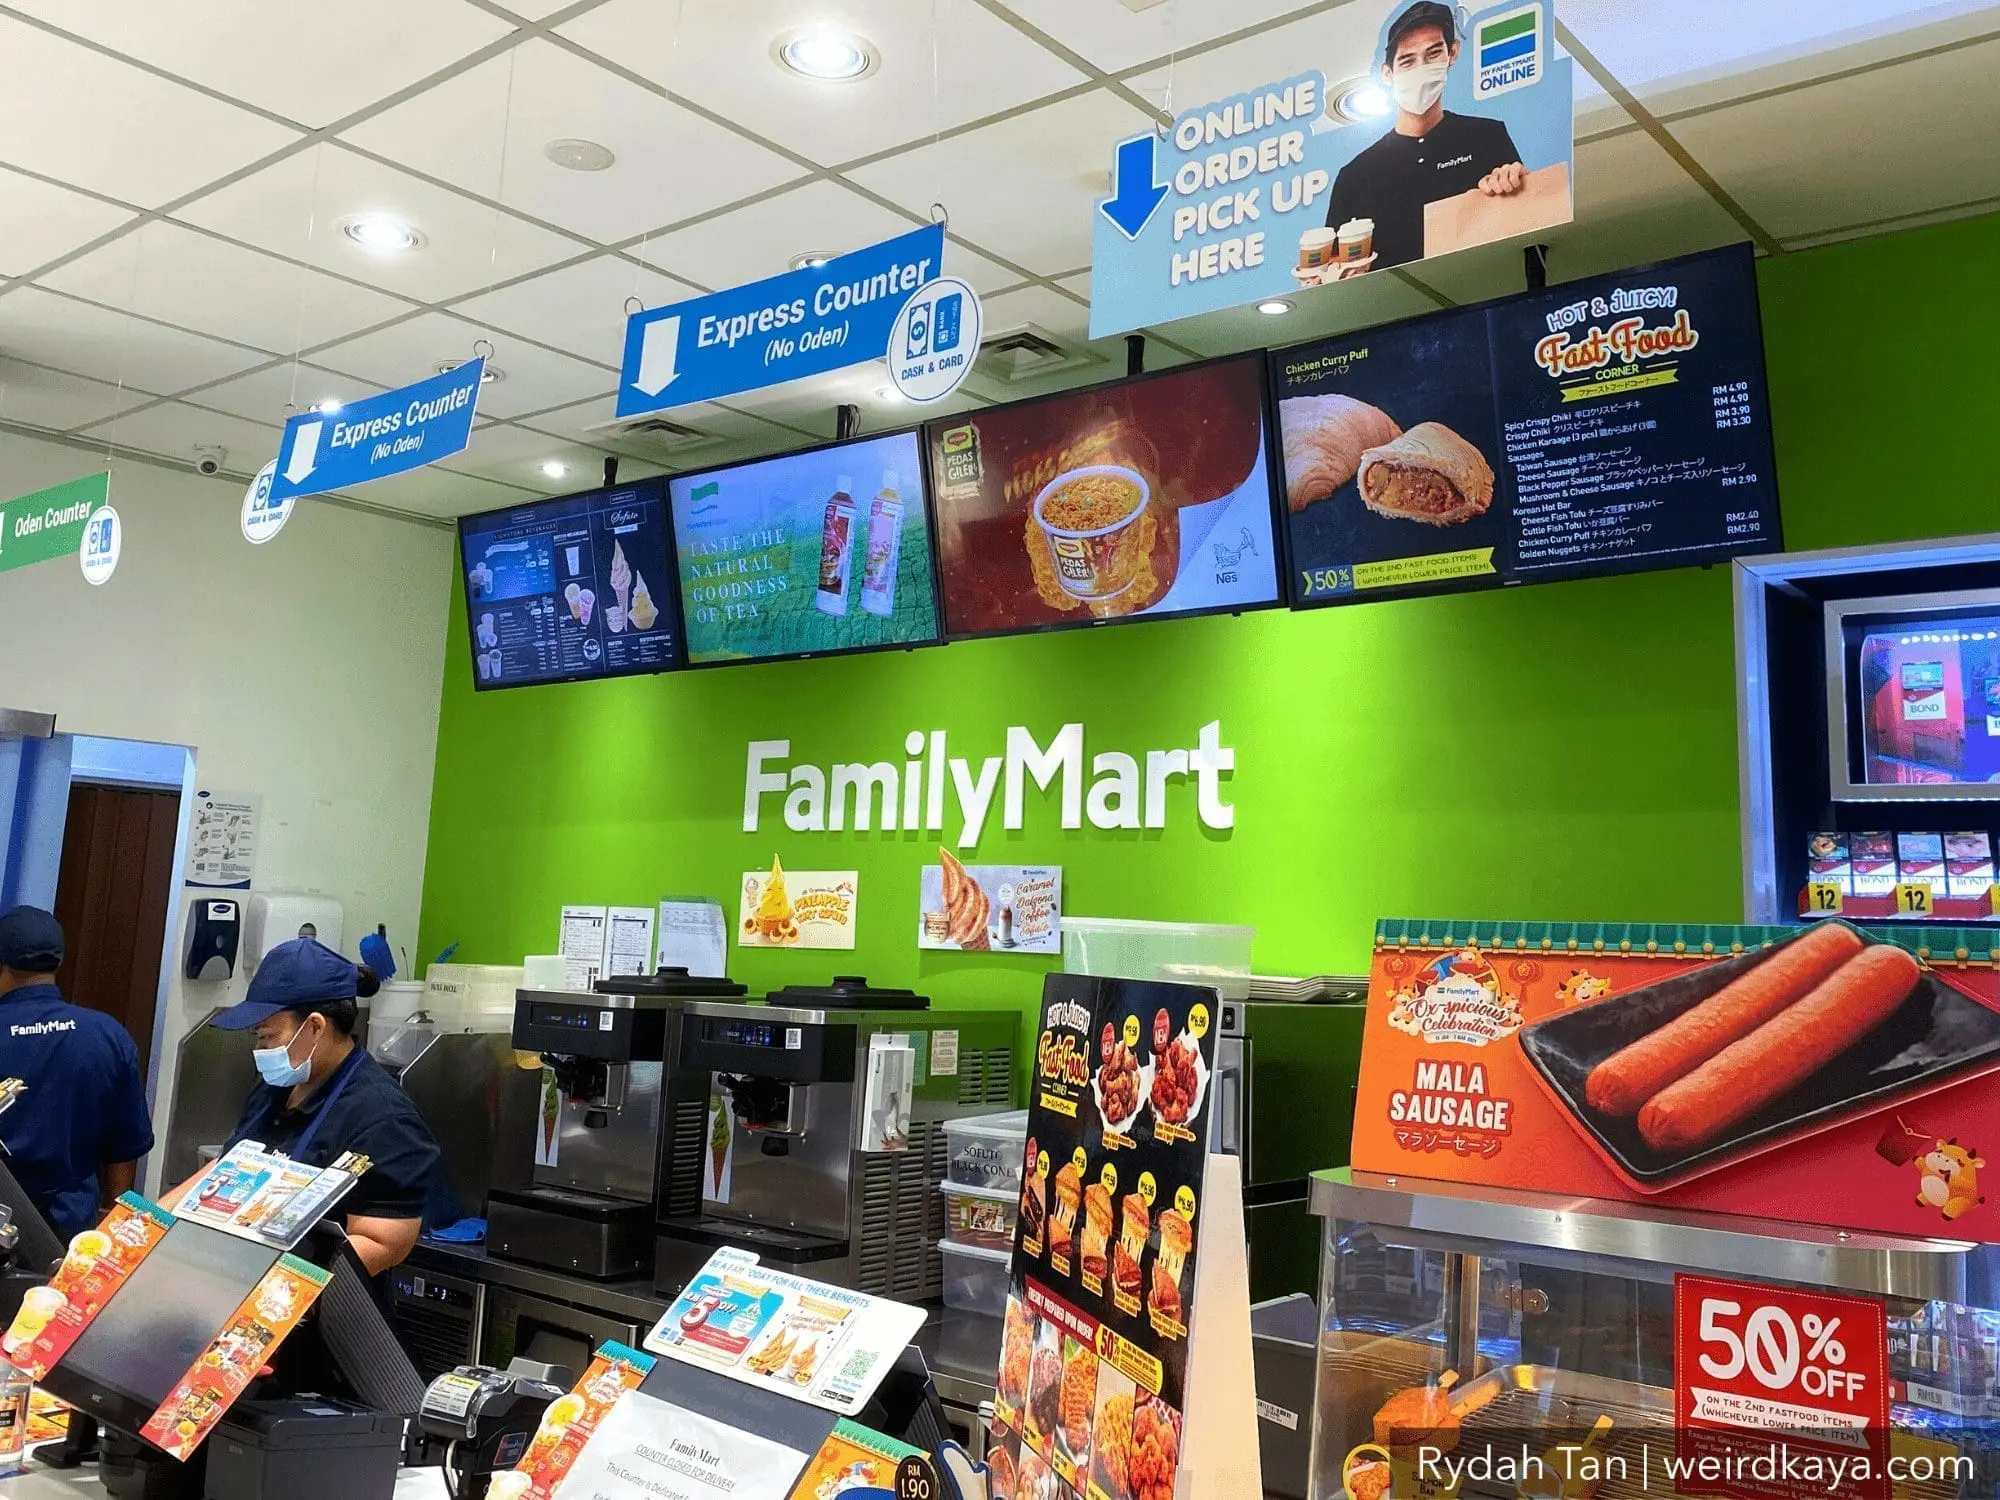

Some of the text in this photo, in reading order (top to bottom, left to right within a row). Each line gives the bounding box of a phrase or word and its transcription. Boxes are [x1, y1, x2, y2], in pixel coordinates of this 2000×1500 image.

[1480, 65, 1536, 92] ONLINE
[1481, 67, 1491, 79] MY
[1174, 79, 1317, 152] ONLINE
[1174, 131, 1304, 196] ORDER
[1436, 153, 1473, 171] FamilyMart
[1173, 169, 1329, 242] PICK UP
[1170, 231, 1265, 287] HERE
[697, 257, 931, 348] Express Counter
[1546, 302, 1587, 331] HOT
[1592, 297, 1607, 317] &
[764, 320, 849, 366] (No Oden)
[1536, 310, 1698, 376] Fast Food
[902, 354, 963, 380] CASH & CARD
[1286, 347, 1368, 375] Chicken Curry Puff
[1595, 364, 1639, 380] CORNER
[1712, 381, 1747, 395] RM 4.90
[1713, 393, 1749, 407] RM 4.90
[331, 383, 474, 450] Express Counter
[1504, 412, 1571, 432] Spicy Crispy Chiki
[1715, 405, 1750, 419] RM 3.90
[1716, 416, 1751, 429] RM 3.30
[1505, 431, 1530, 441] Crispy
[1531, 427, 1551, 437] Chiki
[1506, 440, 1537, 452] Chicken
[1538, 435, 1571, 446] Karaage
[370, 432, 424, 466] (No Oden)
[947, 451, 973, 467] PEDAS
[1507, 452, 1545, 462] Sausages
[1516, 457, 1577, 473] Taiwan Sausage
[1517, 473, 1546, 483] Cheese
[1546, 467, 1580, 478] Sausage
[1518, 474, 1604, 493] Black Pepper Sausage
[1722, 474, 1757, 486] RM 2.90
[1519, 491, 1560, 503] Mushroom
[1570, 487, 1599, 496] Cheese
[1600, 481, 1635, 492] Sausage
[15, 501, 91, 538] Oden Counter
[1513, 501, 1572, 516] Korean Hot Bar
[1521, 510, 1587, 526] Cheese Fish Tofu
[1518, 510, 1759, 548] Chicken Curry Puff RM2.40
[1522, 520, 1582, 536] Cuttle Fish Tofu
[691, 528, 785, 557] TASTE THE
[1519, 548, 1547, 559] Golden
[1548, 544, 1581, 557] Nuggets
[1727, 522, 1760, 534] RM2.90
[691, 554, 773, 581] NATURAL
[1370, 565, 1385, 573] THE
[1404, 560, 1424, 569] FAST
[1427, 558, 1449, 566] FOOD
[1409, 568, 1437, 579] LOWER
[1439, 566, 1463, 575] PRICE
[693, 576, 788, 602] GOODNESS
[696, 603, 758, 624] OF TEA
[1910, 703, 1939, 713] BOND
[742, 720, 1236, 848] FamilyMart
[1016, 877, 1055, 895] Caramel
[1817, 889, 1836, 910] 12
[1905, 890, 1926, 911] 12
[1019, 908, 1050, 923] Coffee
[1446, 987, 1480, 997] FamilyMart
[1406, 998, 1507, 1021] Ox-spicious
[10, 1019, 76, 1036] FamilyMart
[1422, 1015, 1497, 1037] Celebration
[1416, 1062, 1485, 1094] MALA
[1390, 1093, 1509, 1130] SAUSAGE
[1396, 1131, 1496, 1154] マラソーセージ
[951, 1160, 982, 1172] BLACK
[709, 1260, 721, 1268] BE
[773, 1273, 790, 1286] FOR
[790, 1278, 803, 1290] ALL
[805, 1282, 830, 1298] THESE
[830, 1289, 871, 1308] BENEFITS
[680, 1296, 738, 1331] 5 OFF
[1100, 1331, 1113, 1362] 50
[1699, 1298, 1846, 1390] 50%
[1801, 1366, 1866, 1401] OFF
[1706, 1396, 1720, 1404] ON
[1723, 1398, 1741, 1408] THE
[1745, 1400, 1765, 1413] 2ND
[1769, 1405, 1819, 1423] FASTFOOD
[1763, 1417, 1796, 1432] LOWER
[669, 1438, 721, 1467] FamilyMart
[606, 1462, 621, 1476] This
[620, 1469, 646, 1487] Counter
[636, 1444, 737, 1490] COUNTER CLOSED FOR DELIVERY
[908, 1465, 920, 1477] RM
[902, 1478, 929, 1499] 1.90
